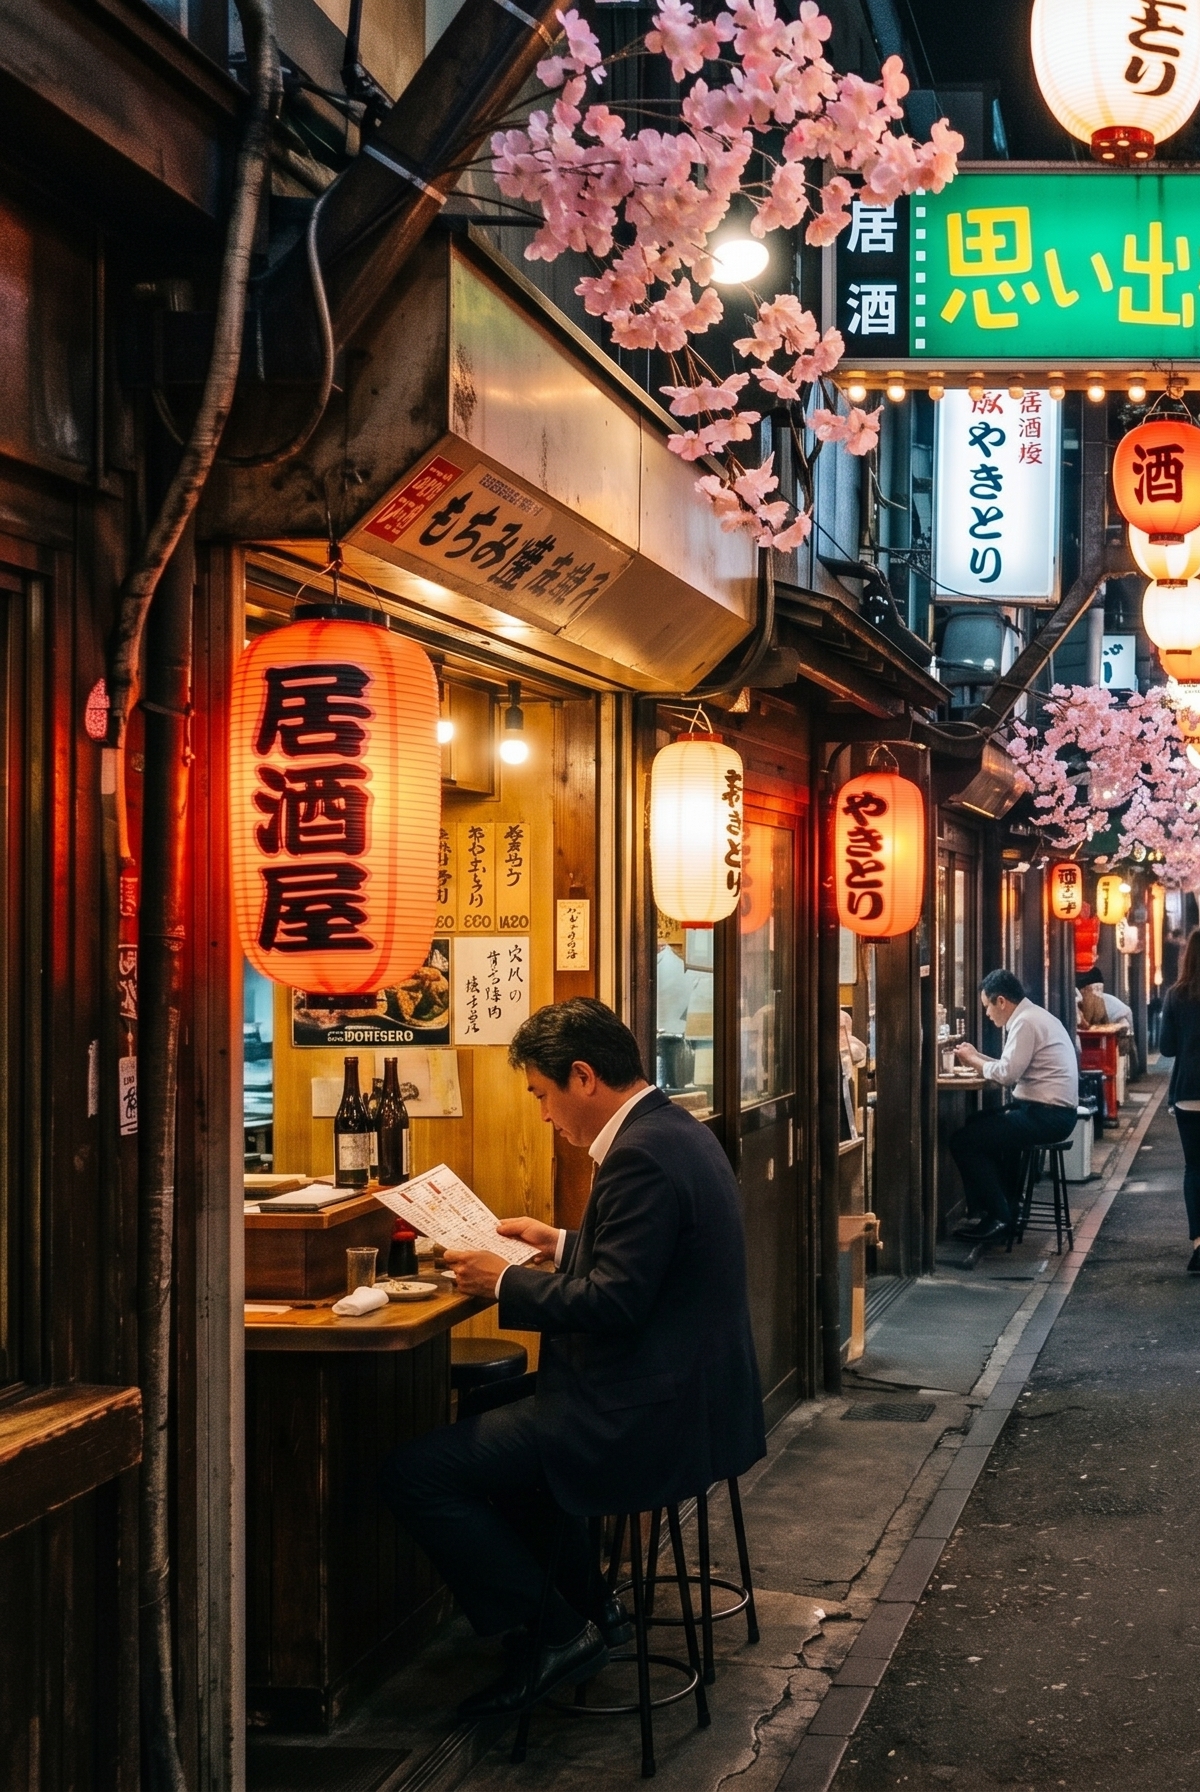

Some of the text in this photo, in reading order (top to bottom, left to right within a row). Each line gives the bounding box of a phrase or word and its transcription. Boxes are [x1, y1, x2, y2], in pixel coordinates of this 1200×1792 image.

[968, 421, 1007, 584] やきとり
[1132, 443, 1185, 505] 酒
[256, 663, 374, 953] 居酒屋
[842, 791, 888, 920] やきとり
